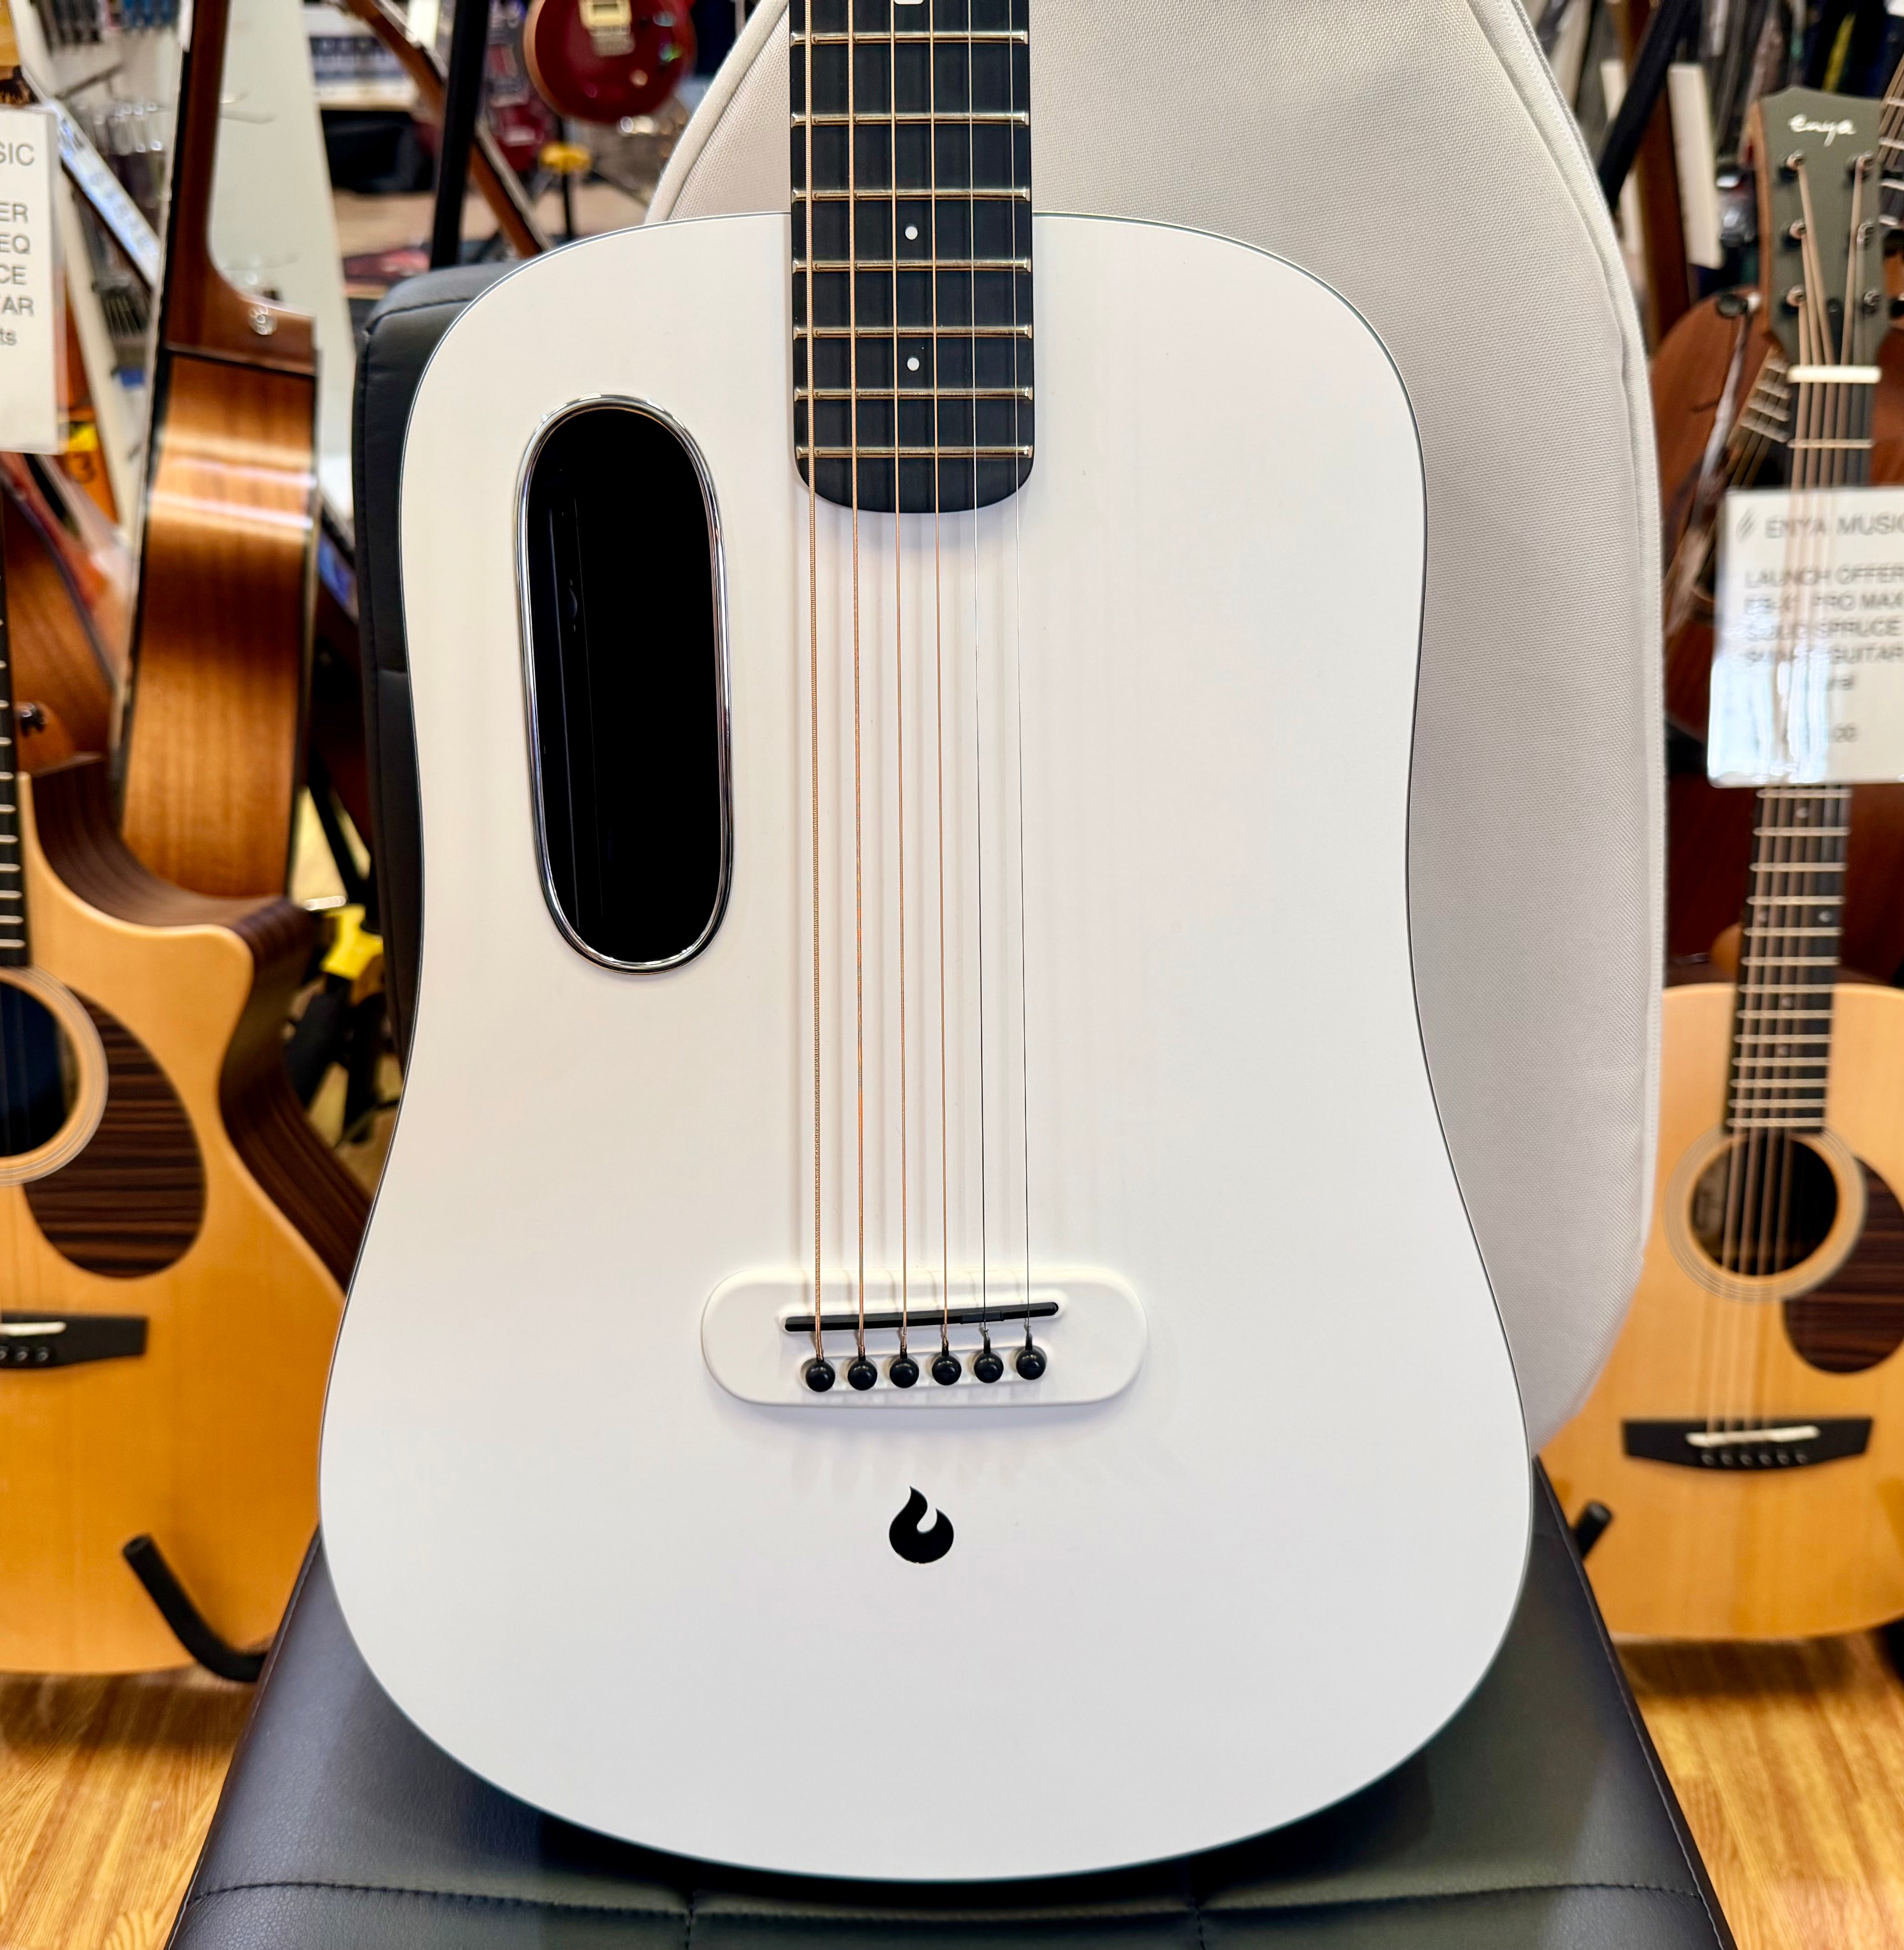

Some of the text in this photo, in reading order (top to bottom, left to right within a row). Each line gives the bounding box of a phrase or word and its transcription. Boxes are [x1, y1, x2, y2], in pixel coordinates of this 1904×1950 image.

[1788, 114, 1857, 147] enya
[0, 294, 35, 317] AR
[1766, 515, 1827, 538] ENYA
